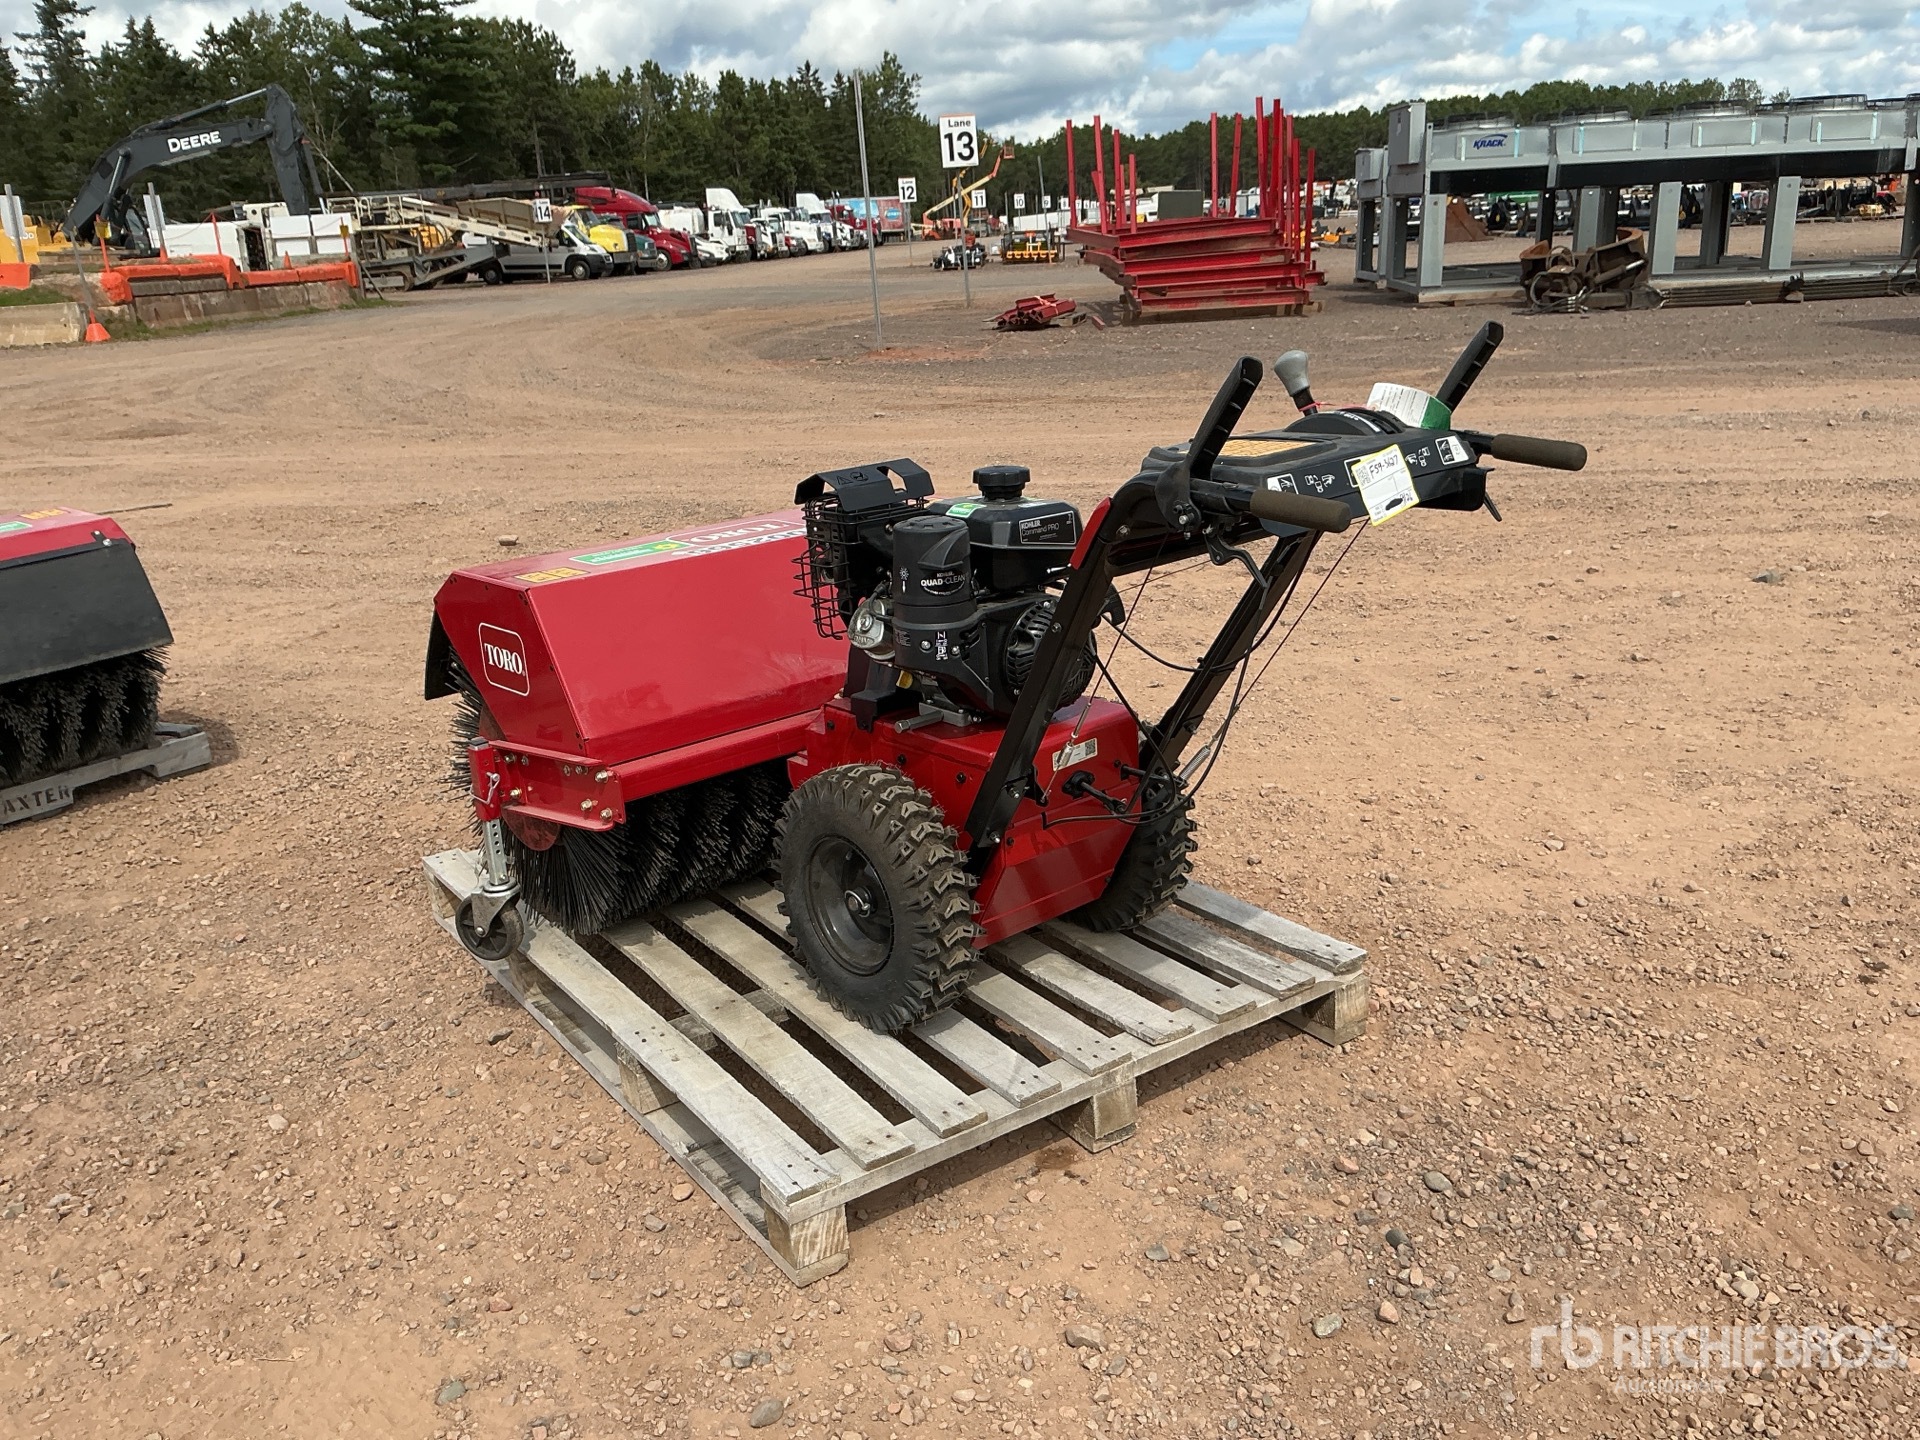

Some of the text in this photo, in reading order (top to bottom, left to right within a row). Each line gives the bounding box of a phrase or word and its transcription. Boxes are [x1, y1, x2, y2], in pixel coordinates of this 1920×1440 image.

[948, 119, 971, 127] Lane
[167, 131, 221, 152] DEERE
[944, 131, 974, 161] 13
[1473, 139, 1504, 150] KRACK
[900, 186, 915, 200] 12
[974, 195, 984, 206] 11
[1016, 199, 1024, 207] 10
[538, 206, 551, 220] 14
[1021, 520, 1042, 530] KOHLER
[1022, 525, 1048, 536] Command
[1047, 523, 1060, 531] PRO
[484, 643, 523, 675] TORO
